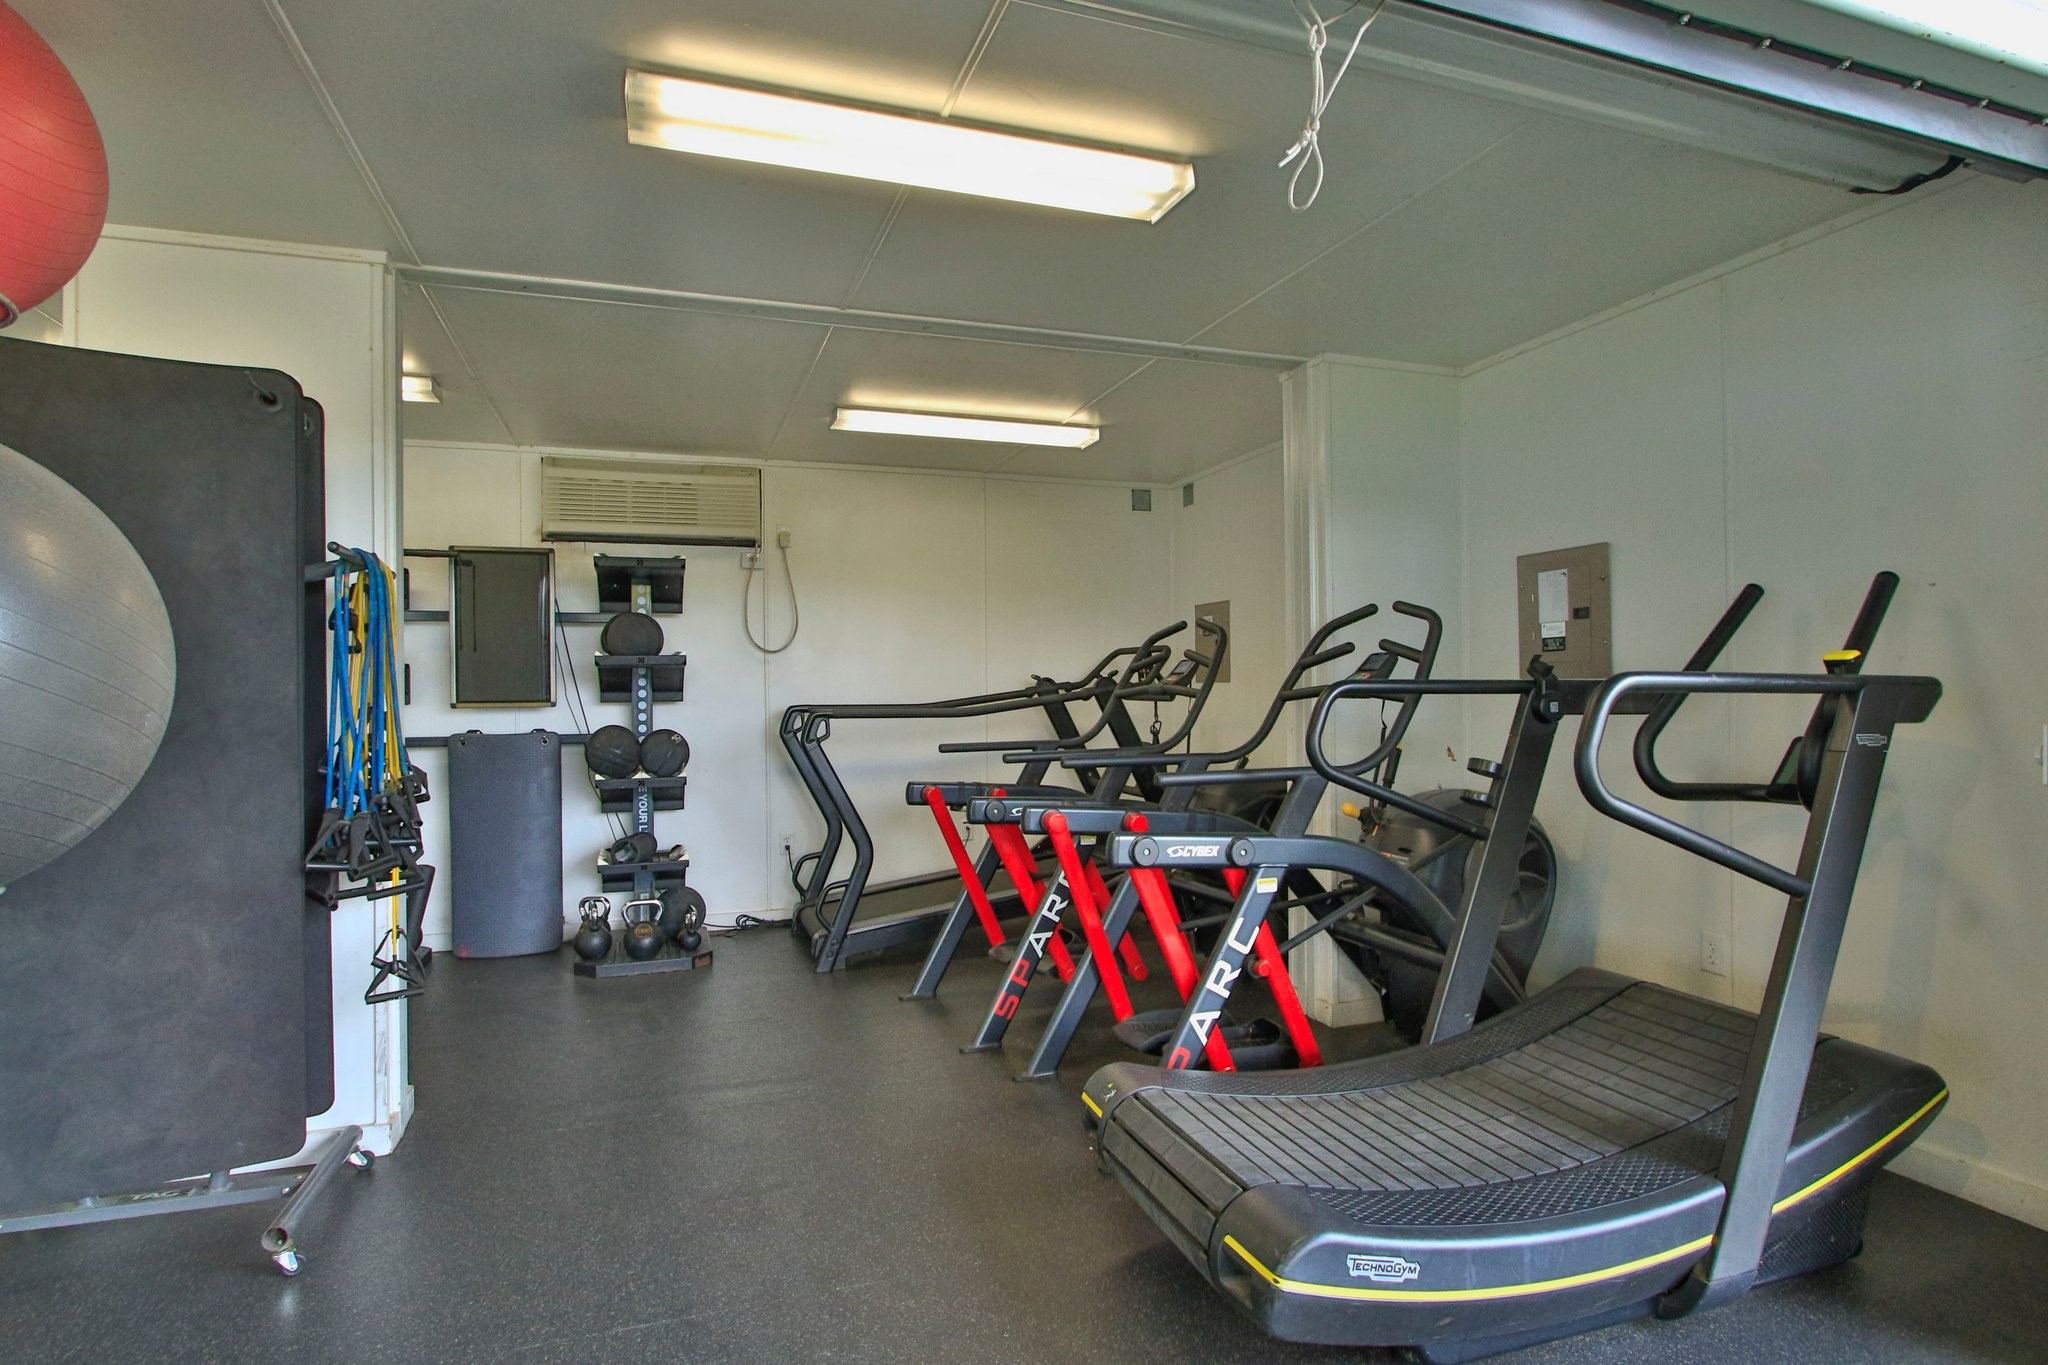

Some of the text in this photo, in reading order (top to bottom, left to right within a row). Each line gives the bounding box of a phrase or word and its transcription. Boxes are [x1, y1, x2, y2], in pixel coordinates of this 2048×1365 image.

[638, 793, 648, 823] YOUR
[1182, 845, 1220, 857] CYBEX
[1167, 917, 1260, 1070] PARC
